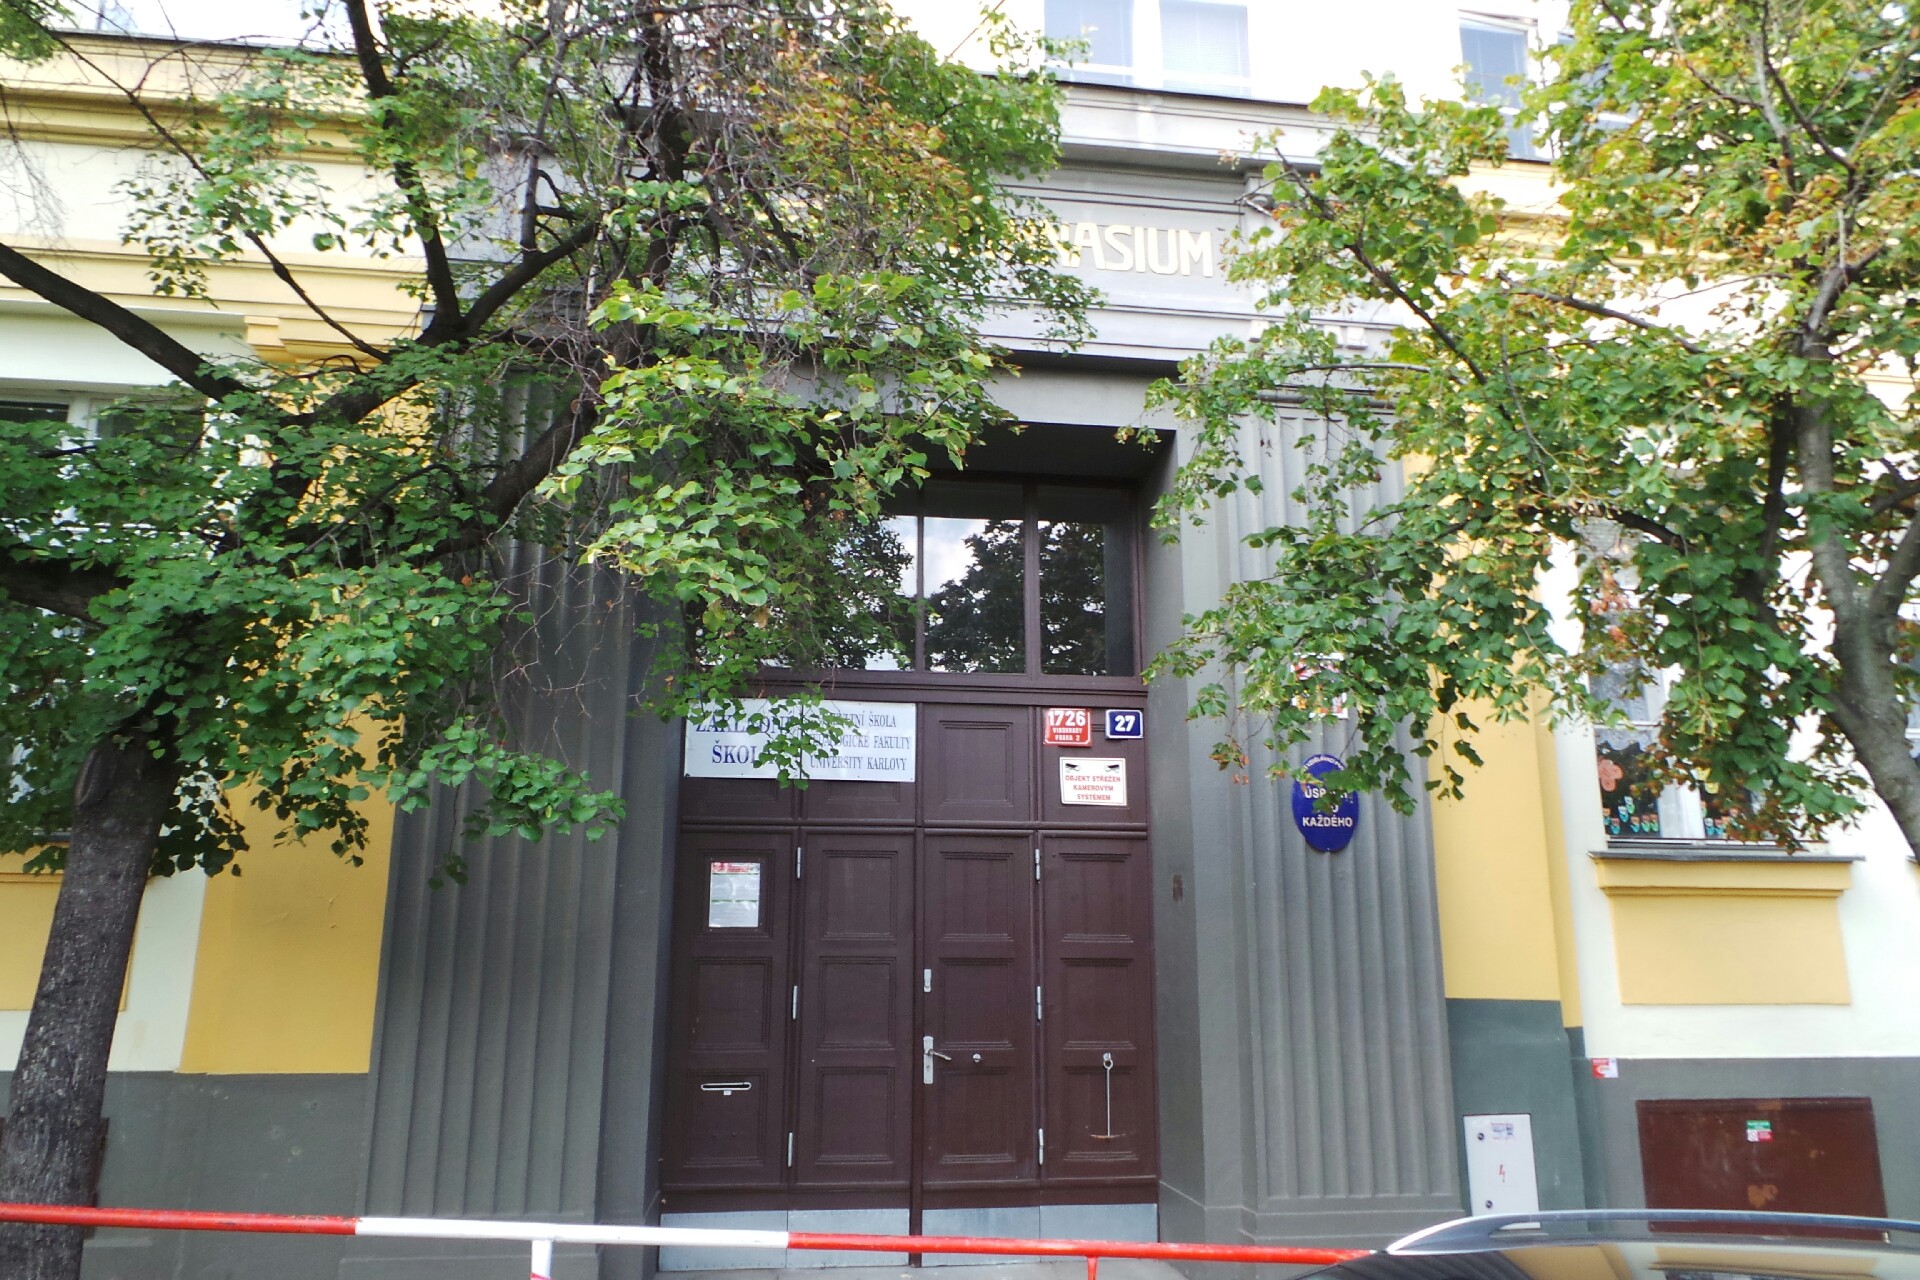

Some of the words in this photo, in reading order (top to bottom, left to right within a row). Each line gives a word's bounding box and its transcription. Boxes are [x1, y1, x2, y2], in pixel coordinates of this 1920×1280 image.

[696, 710, 792, 733] ÁKLDN
[869, 711, 897, 727] ŠKOLA
[1048, 710, 1086, 726] 1726
[1115, 716, 1135, 731] 27
[808, 732, 869, 748] OGICKÉ
[873, 735, 911, 749] FAKULTY
[711, 739, 774, 764] ŠKOL
[810, 755, 863, 769] UNIVERSITY
[867, 757, 907, 771] KARLOVY
[1092, 774, 1121, 782] STŘEŽEN
[1304, 785, 1348, 799] ÚSP
[1303, 815, 1352, 826] KAŽDÉHO
